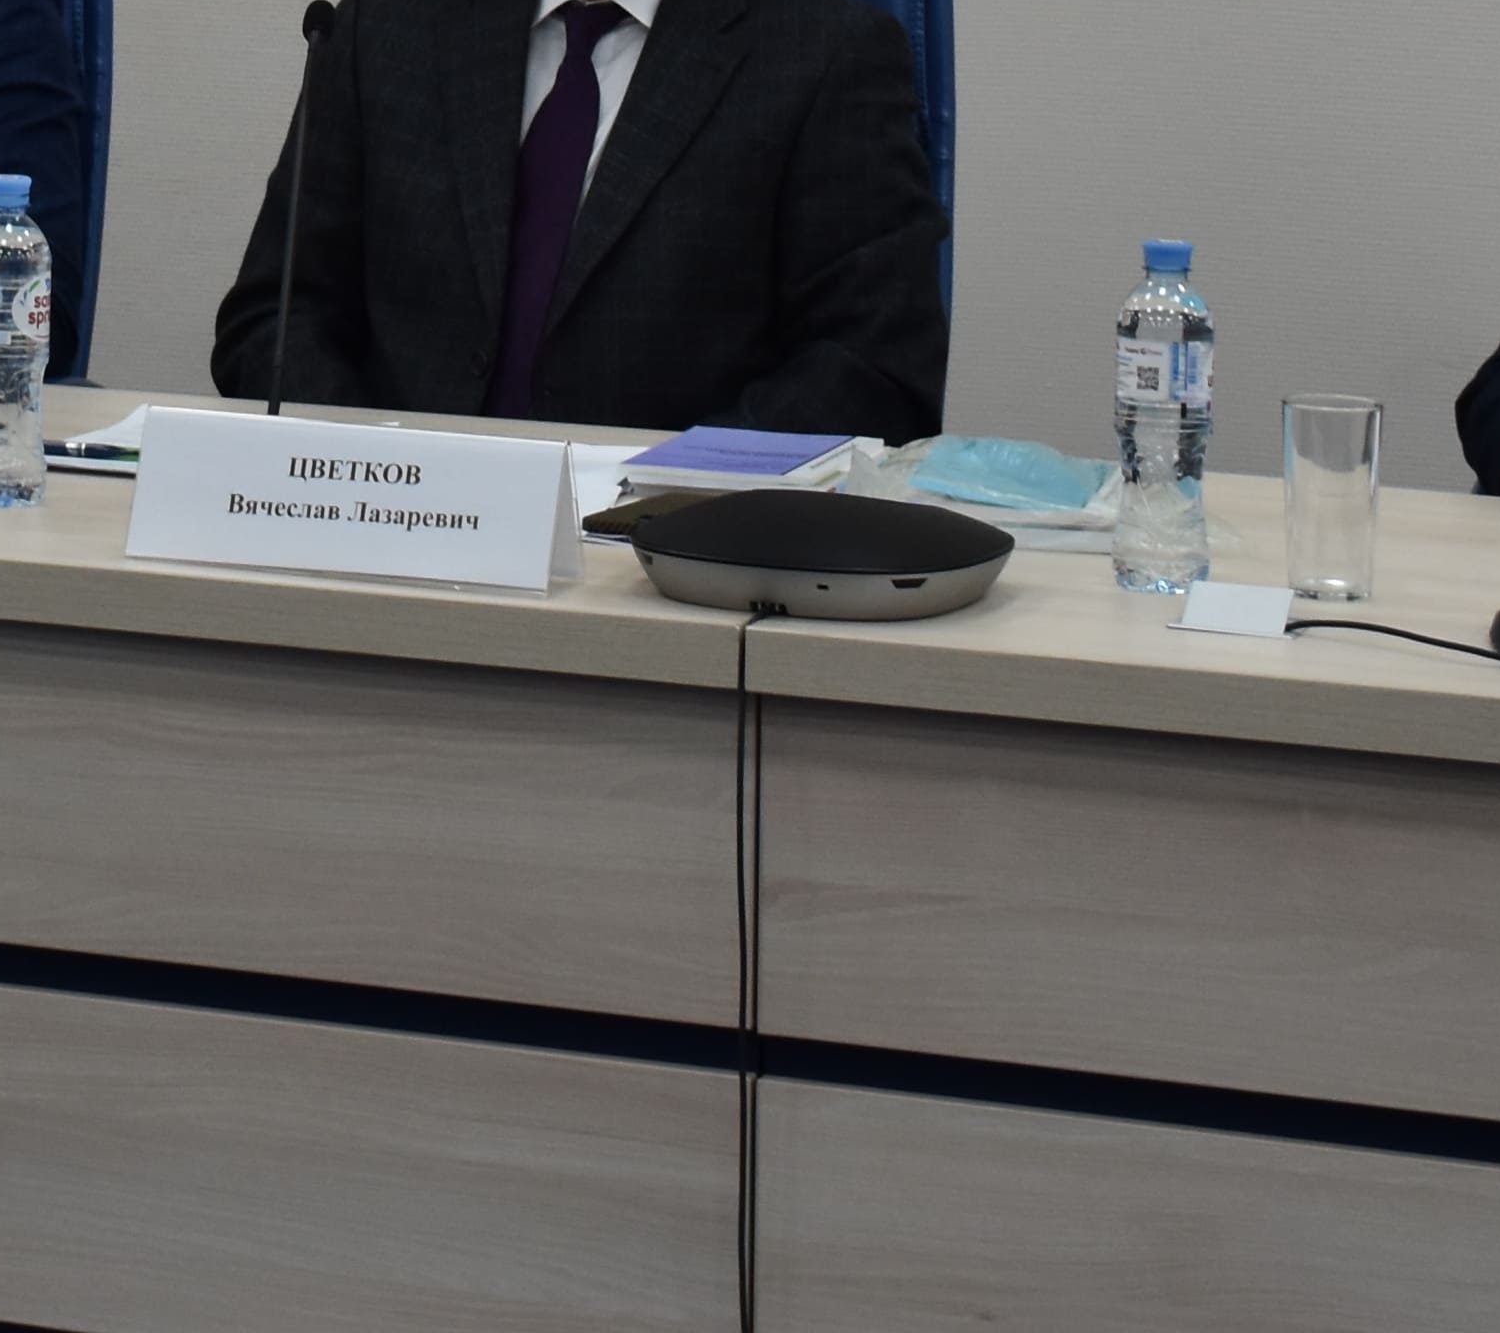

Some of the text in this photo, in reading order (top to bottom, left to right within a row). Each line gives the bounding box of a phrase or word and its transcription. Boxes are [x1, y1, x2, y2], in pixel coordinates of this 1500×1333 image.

[288, 456, 422, 486] ЦВЕТКОВ
[228, 492, 480, 532] Вячеслав Лазаревич
